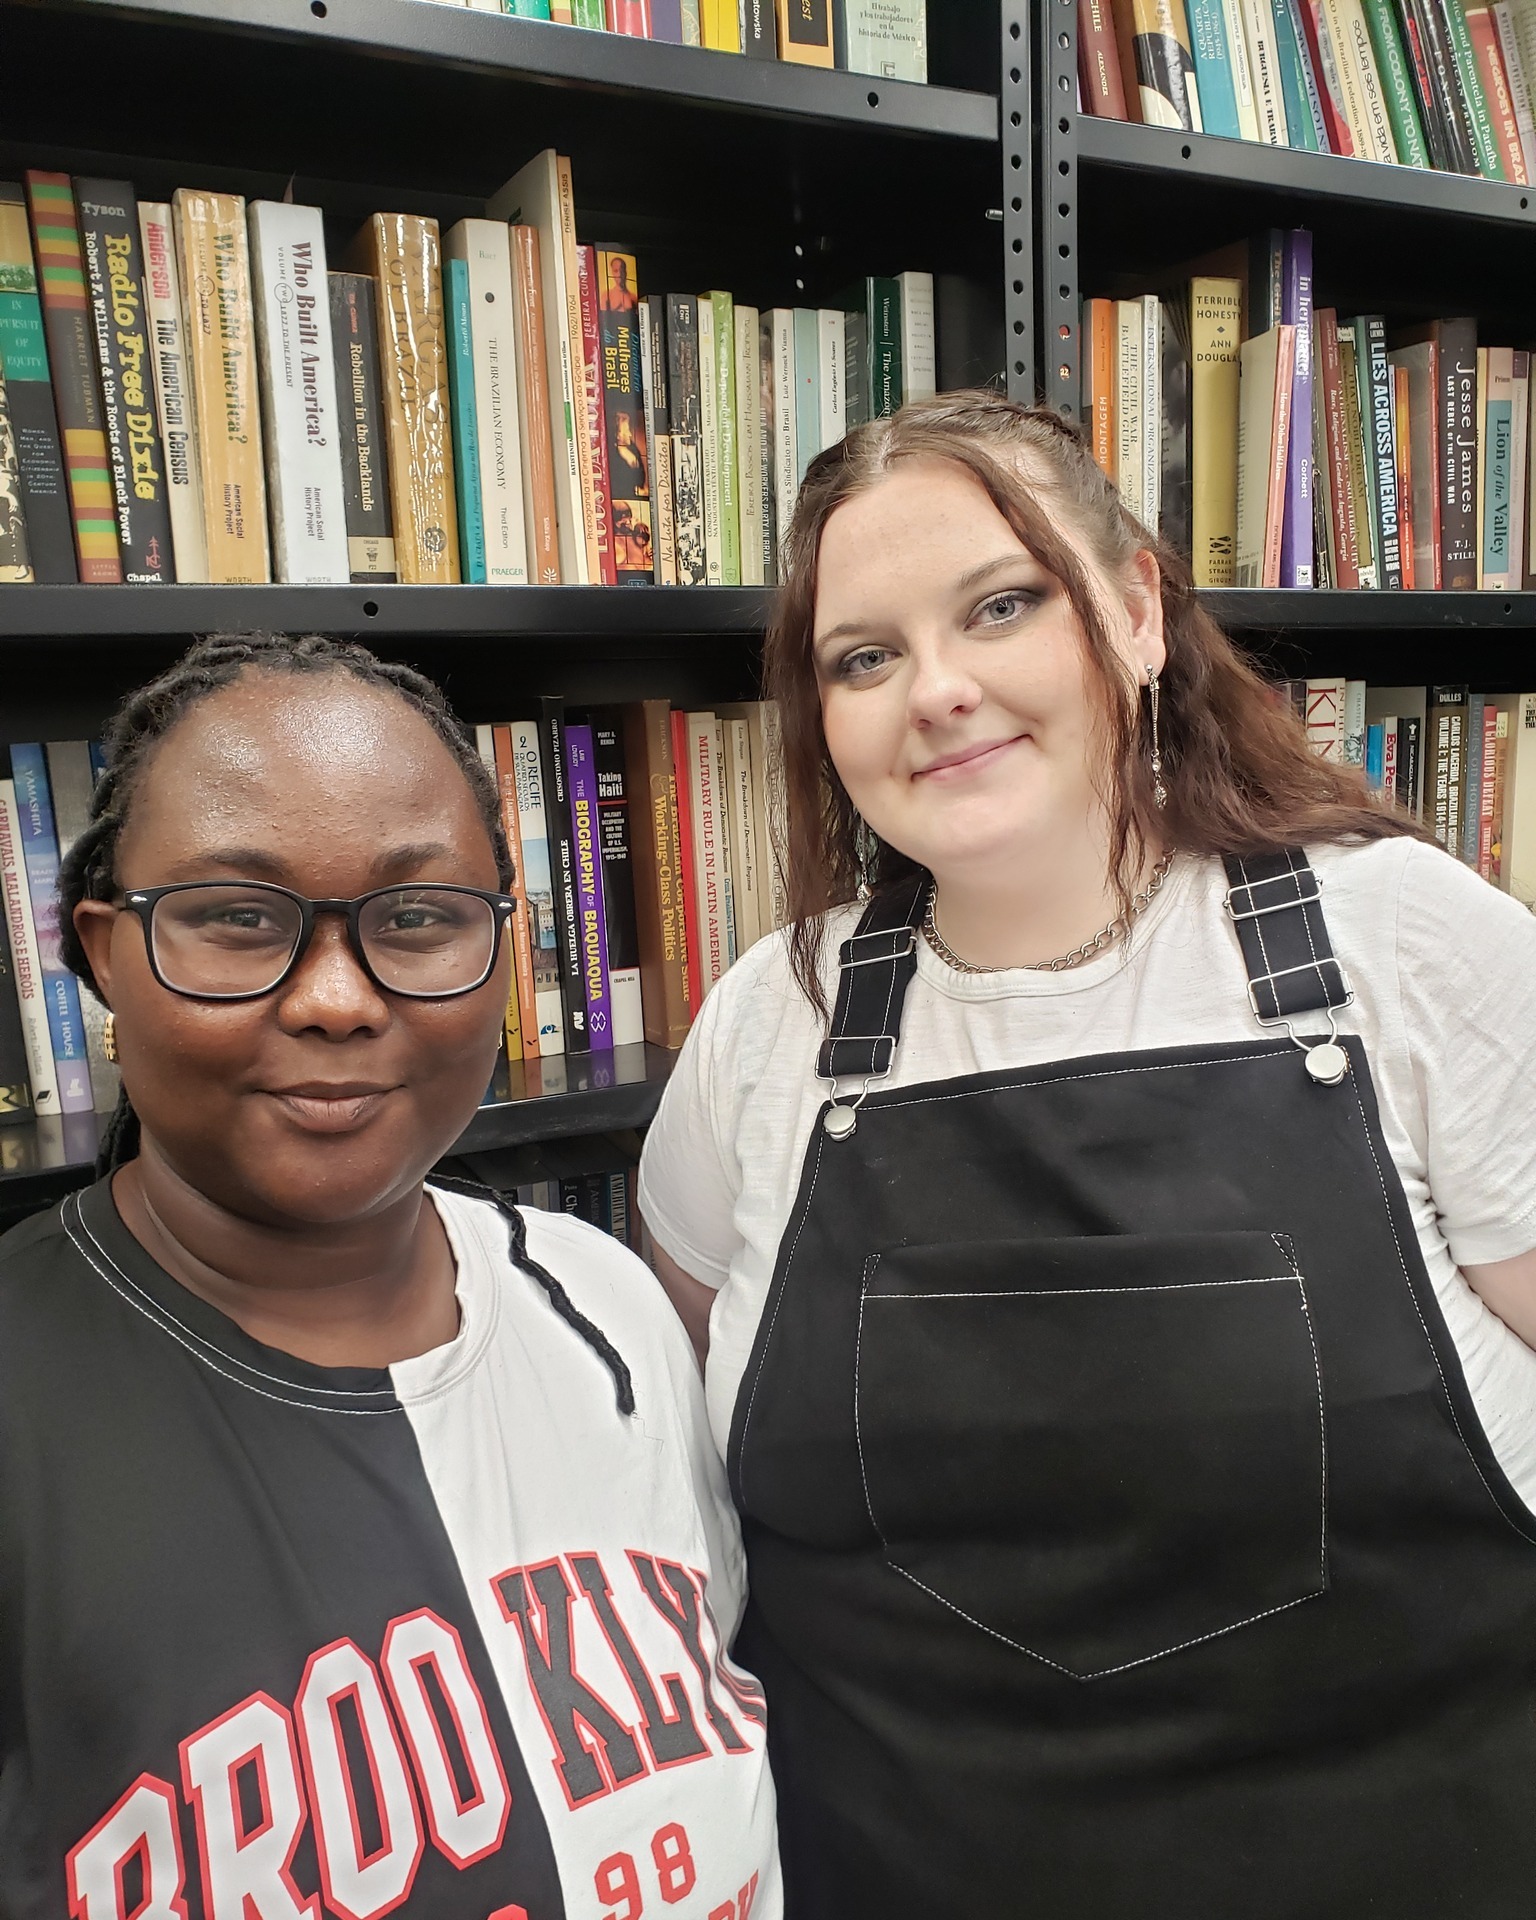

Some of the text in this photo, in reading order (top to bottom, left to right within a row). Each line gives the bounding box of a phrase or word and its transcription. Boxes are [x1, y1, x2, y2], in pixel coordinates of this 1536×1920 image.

[1195, 8, 1205, 50] QUARTA
[1097, 50, 1109, 96] ALEXANDER
[1378, 7, 1393, 48] FROM
[1388, 52, 1410, 114] COLONY
[1404, 116, 1416, 138] TO
[1458, 26, 1470, 47] and
[1465, 51, 1484, 107] Parentela
[1478, 110, 1487, 121] in
[1486, 45, 1513, 115] NEGROES
[1505, 120, 1518, 138] IN
[81, 202, 125, 218] Tyson
[561, 173, 572, 233] DENISE ASSIS
[146, 222, 190, 485] Anderson The American Census
[212, 234, 248, 444] Who Built America?
[291, 241, 327, 447] Who Built America?
[616, 325, 631, 394] Mulheres
[1210, 340, 1231, 348] ANN
[1370, 342, 1386, 380] LIES
[85, 231, 133, 545] Robert F. Williams & the Roots of Black Power
[104, 235, 159, 500] Radio Free Dixie
[604, 347, 620, 390] Brasil
[883, 352, 892, 414] The Amazon
[1121, 324, 1130, 461] BATTLEFIELD GUIDE
[1130, 345, 1138, 443] THE CIVIL WAR
[1447, 375, 1455, 397] LAST
[349, 342, 374, 511] Rebellion in the Backlands
[487, 337, 507, 490] THE BRAZILIAN ECONOMY
[720, 367, 734, 507] Dependent Development
[1099, 396, 1108, 464] MONTAGEM
[1147, 326, 1155, 514] INTERNATIONAL ORGANIZATIONS
[1373, 384, 1390, 455] ACROSS
[1447, 401, 1455, 428] REBEL
[1456, 362, 1475, 514] Jesse James
[1496, 419, 1510, 460] Lion
[1300, 459, 1309, 498] Corbett
[1378, 457, 1398, 536] AMERICA
[1447, 458, 1455, 483] CIVIL
[1447, 485, 1455, 505] WAR
[1494, 465, 1505, 479] of
[1494, 481, 1506, 500] the
[304, 487, 315, 537] History Project
[314, 487, 325, 541] American Social
[499, 507, 510, 549] Third Edition
[1490, 503, 1509, 557] Valley
[491, 568, 524, 576] PRAEGER
[1455, 540, 1471, 548] T.J.
[127, 573, 162, 581] Chapel
[1439, 694, 1461, 702] DULLES
[571, 745, 579, 767] LOVEJOY
[1451, 716, 1460, 746] CARLOS
[525, 751, 541, 809] O RECIFE
[550, 719, 565, 802] CRISOSTOMO PIZARRO
[598, 773, 622, 782] Taking
[1449, 748, 1459, 785] LACERDA,
[24, 768, 43, 836] YAMASHITA
[599, 783, 623, 797] Haiti
[1448, 786, 1458, 826] BRAZILIAN
[1467, 783, 1481, 860] HORSEBACK
[653, 794, 673, 906] Working-Class
[698, 735, 721, 983] MILITARY RULE IN LATIN AMERICA
[560, 840, 580, 975] LA HUELGA OBRERA EN CHILE
[574, 779, 603, 1001] THE BIOGRAPHY OF BAQUAQUA
[662, 908, 676, 961] Politics
